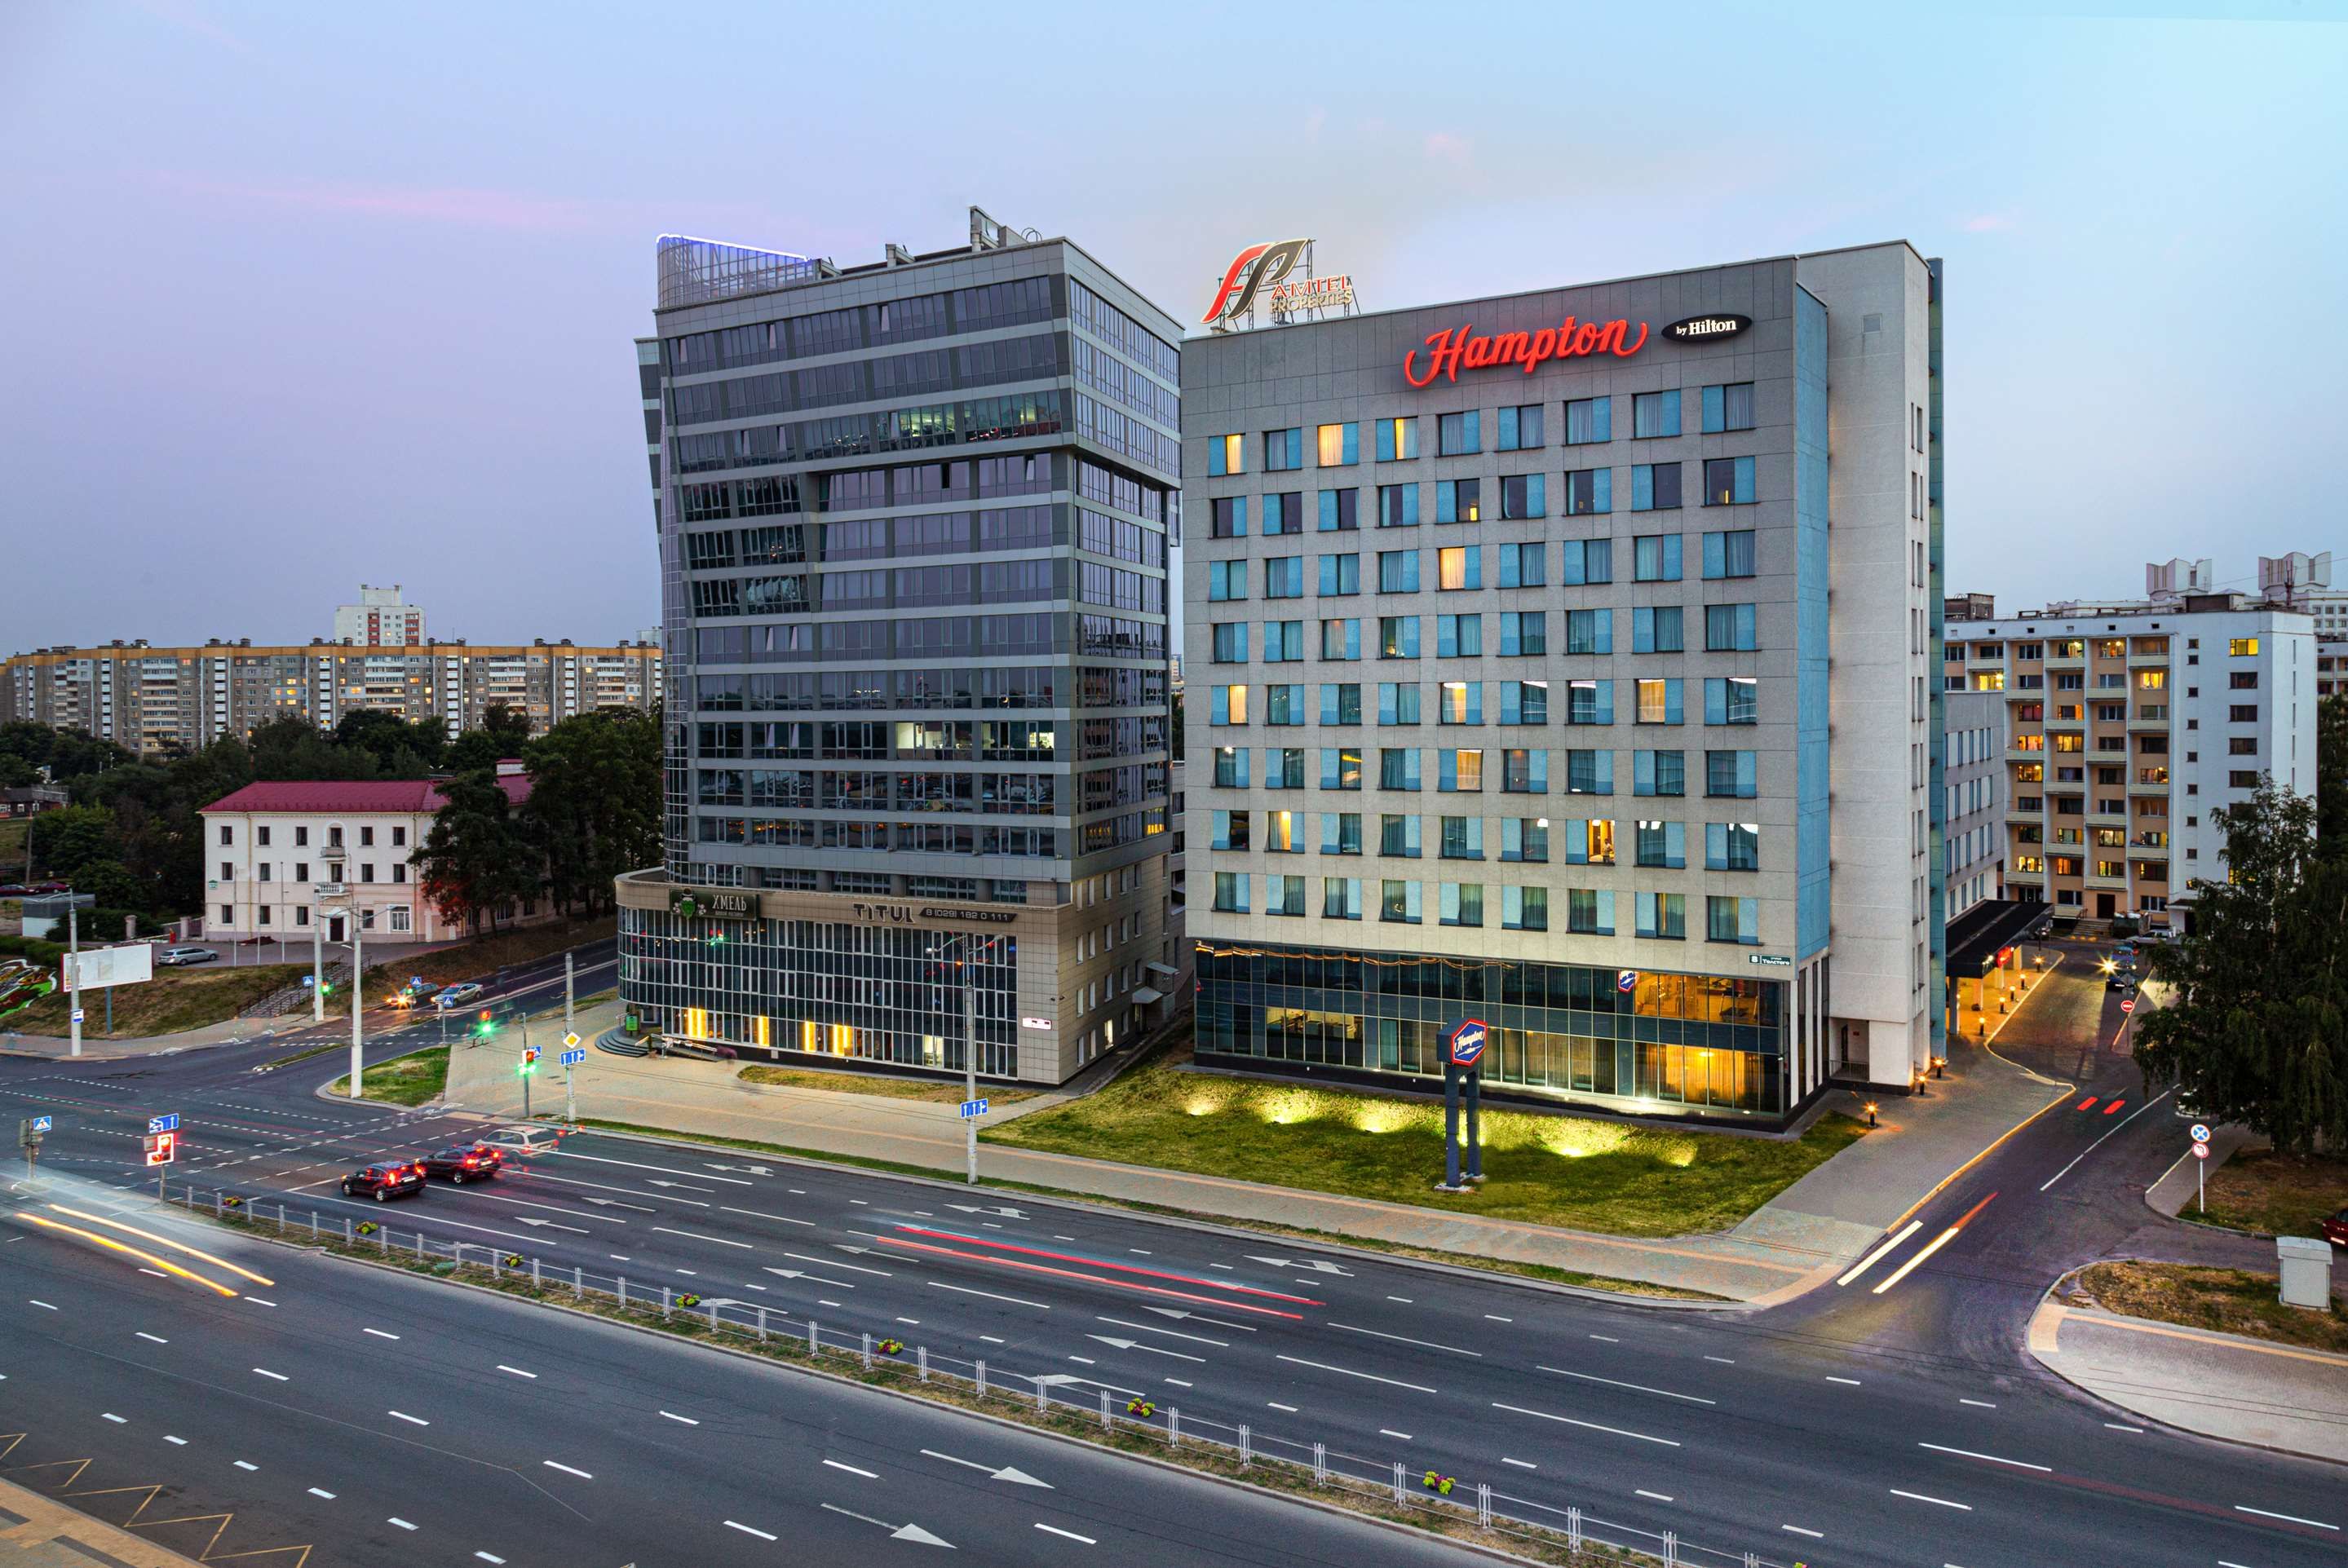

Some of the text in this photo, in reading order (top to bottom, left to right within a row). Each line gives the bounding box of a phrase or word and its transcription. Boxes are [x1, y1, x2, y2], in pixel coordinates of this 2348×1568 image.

[1271, 274, 1351, 300] AMTEL
[1270, 289, 1352, 314] PROPERTIES
[1676, 319, 1736, 336] by Hilton
[1404, 316, 1648, 387] Hampton
[712, 894, 747, 912] ХМЕЛЬ
[926, 908, 933, 917] 8
[991, 912, 1008, 921] 111
[1751, 955, 1759, 963] 8
[1454, 1030, 1485, 1053] Hampton
